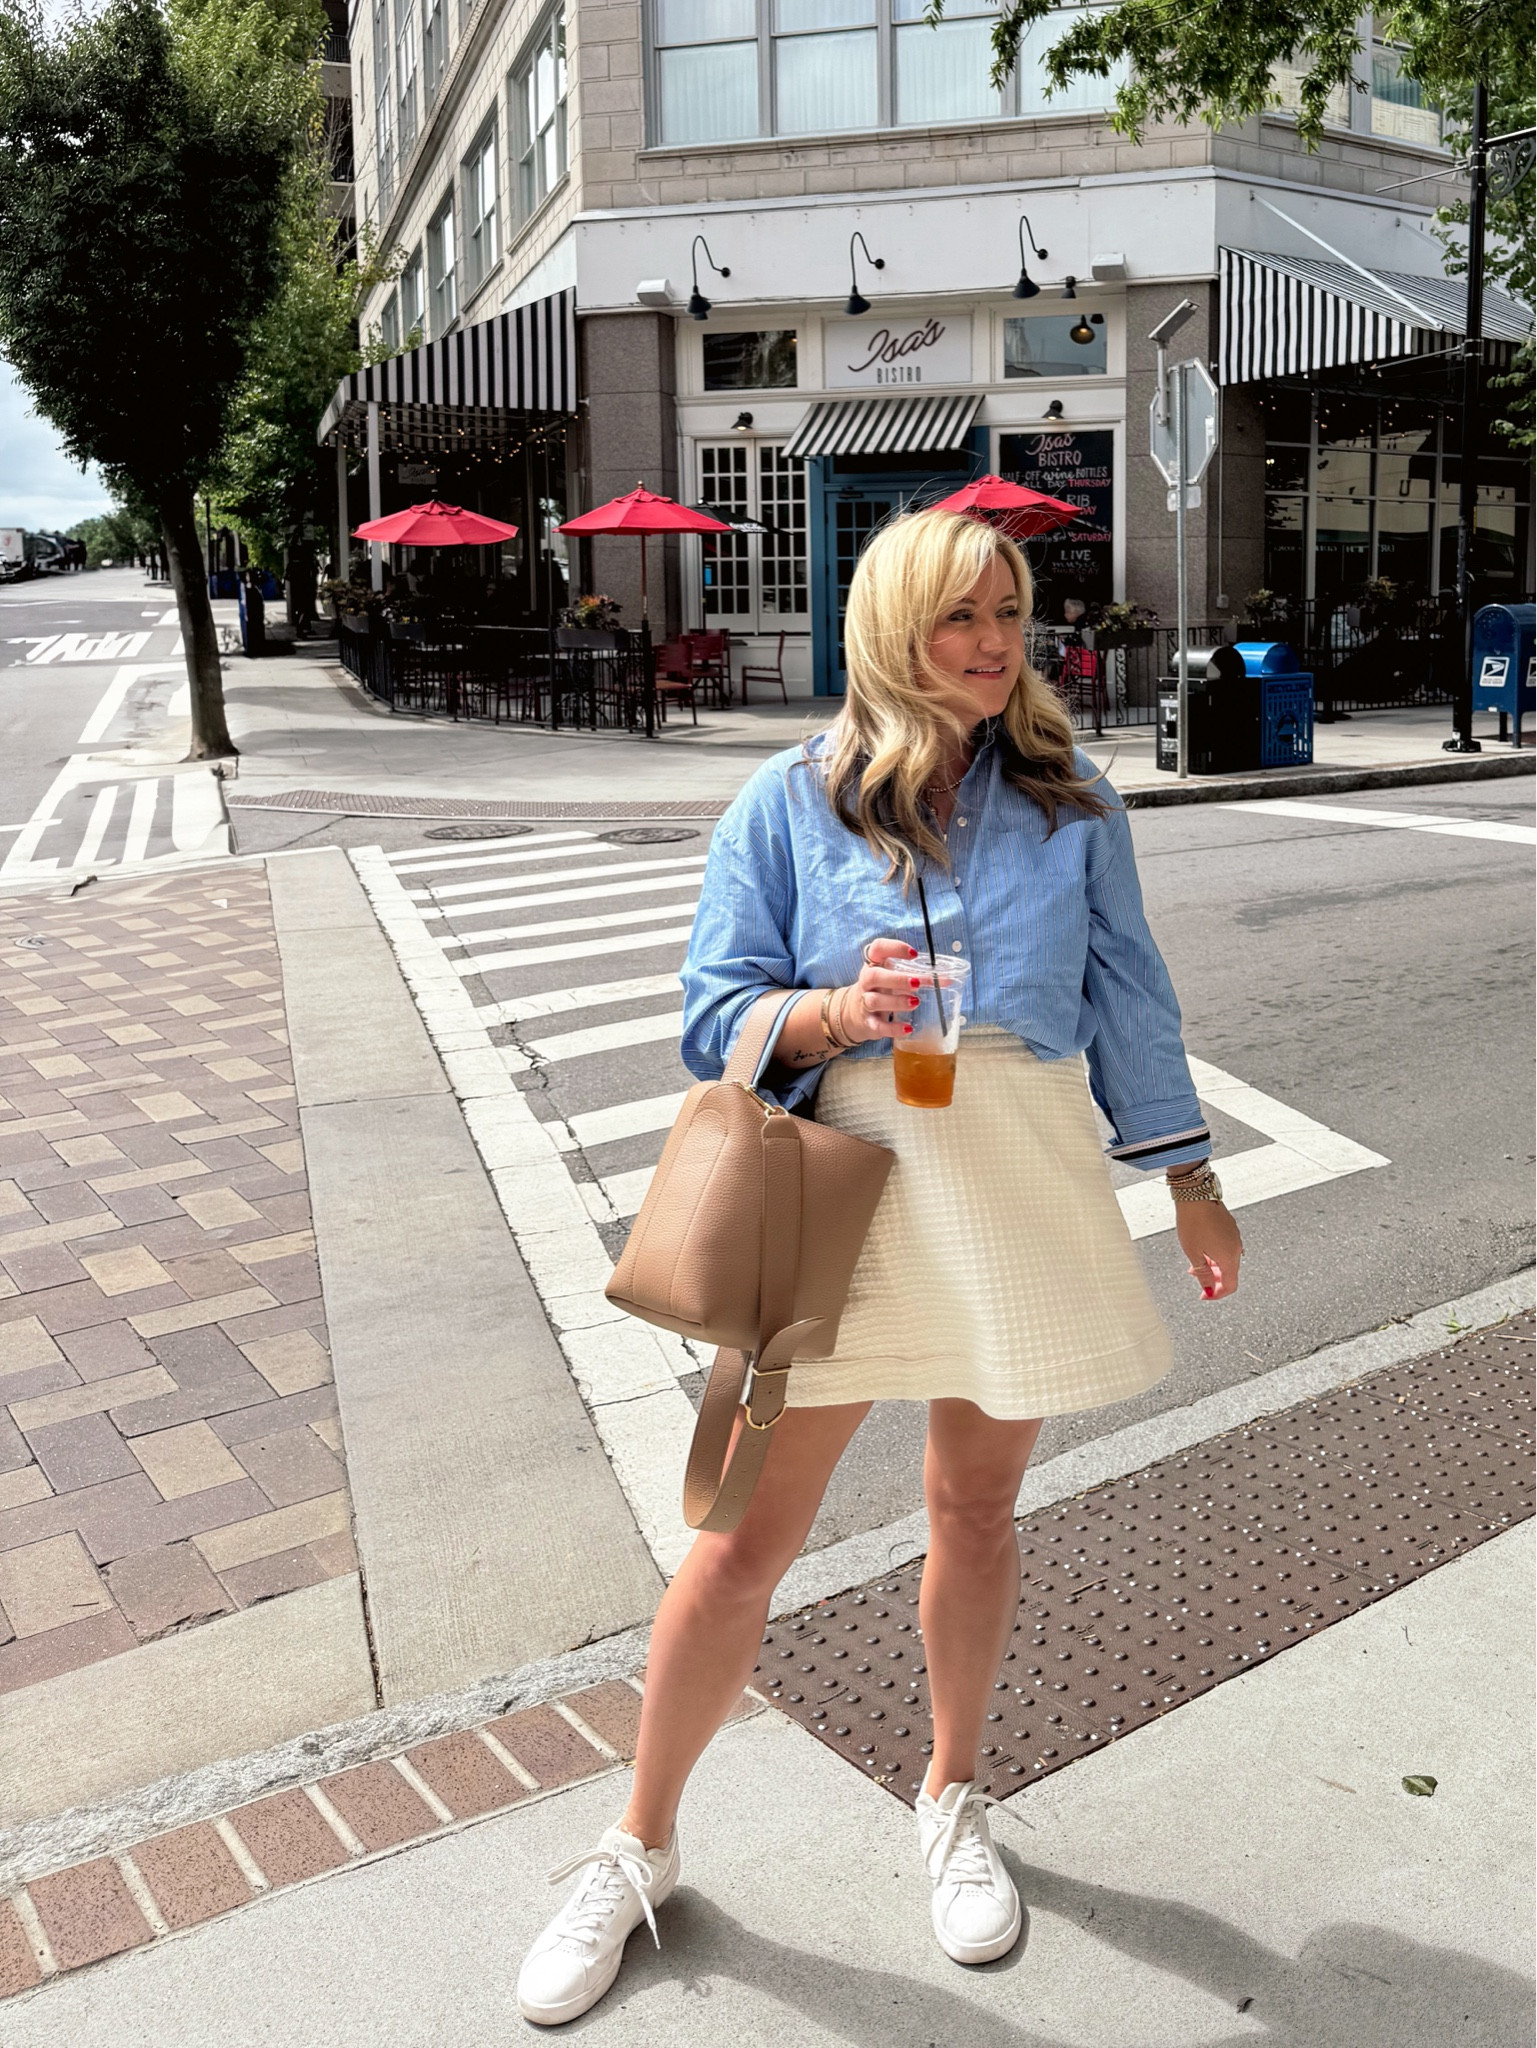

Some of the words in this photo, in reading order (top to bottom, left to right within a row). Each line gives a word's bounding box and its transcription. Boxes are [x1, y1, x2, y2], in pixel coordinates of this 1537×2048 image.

[848, 318, 946, 372] Isa's
[877, 366, 921, 384] BISTRO
[1038, 450, 1082, 467] BISTRO
[1042, 467, 1075, 481] wine
[1075, 466, 1108, 479] BOTTLES
[1047, 480, 1067, 489] DAY
[1068, 478, 1112, 488] THURSDAY
[1066, 493, 1090, 508] RIB
[1071, 532, 1112, 543] SATURDAY
[1060, 549, 1092, 561] LIVE
